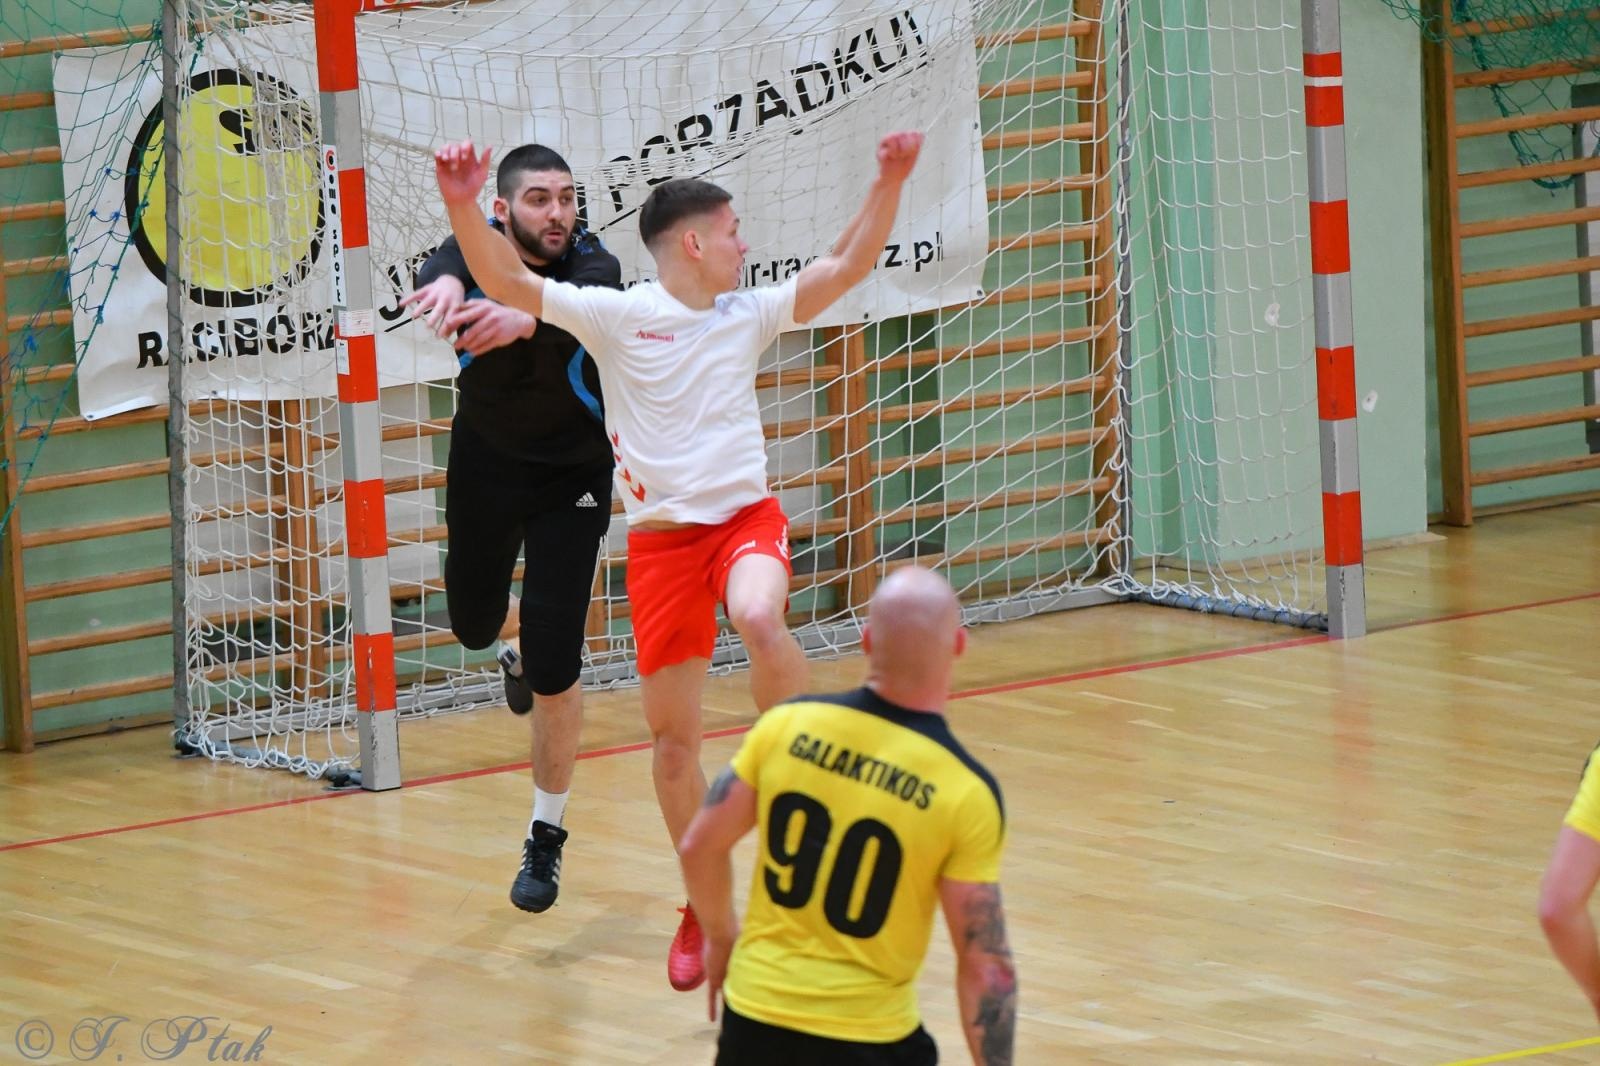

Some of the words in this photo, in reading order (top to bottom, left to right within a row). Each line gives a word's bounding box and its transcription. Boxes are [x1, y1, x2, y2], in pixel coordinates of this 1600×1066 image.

[136, 304, 335, 369] RCIBÓR
[788, 733, 937, 811] GALAKTIKOS
[764, 790, 904, 940] 90
